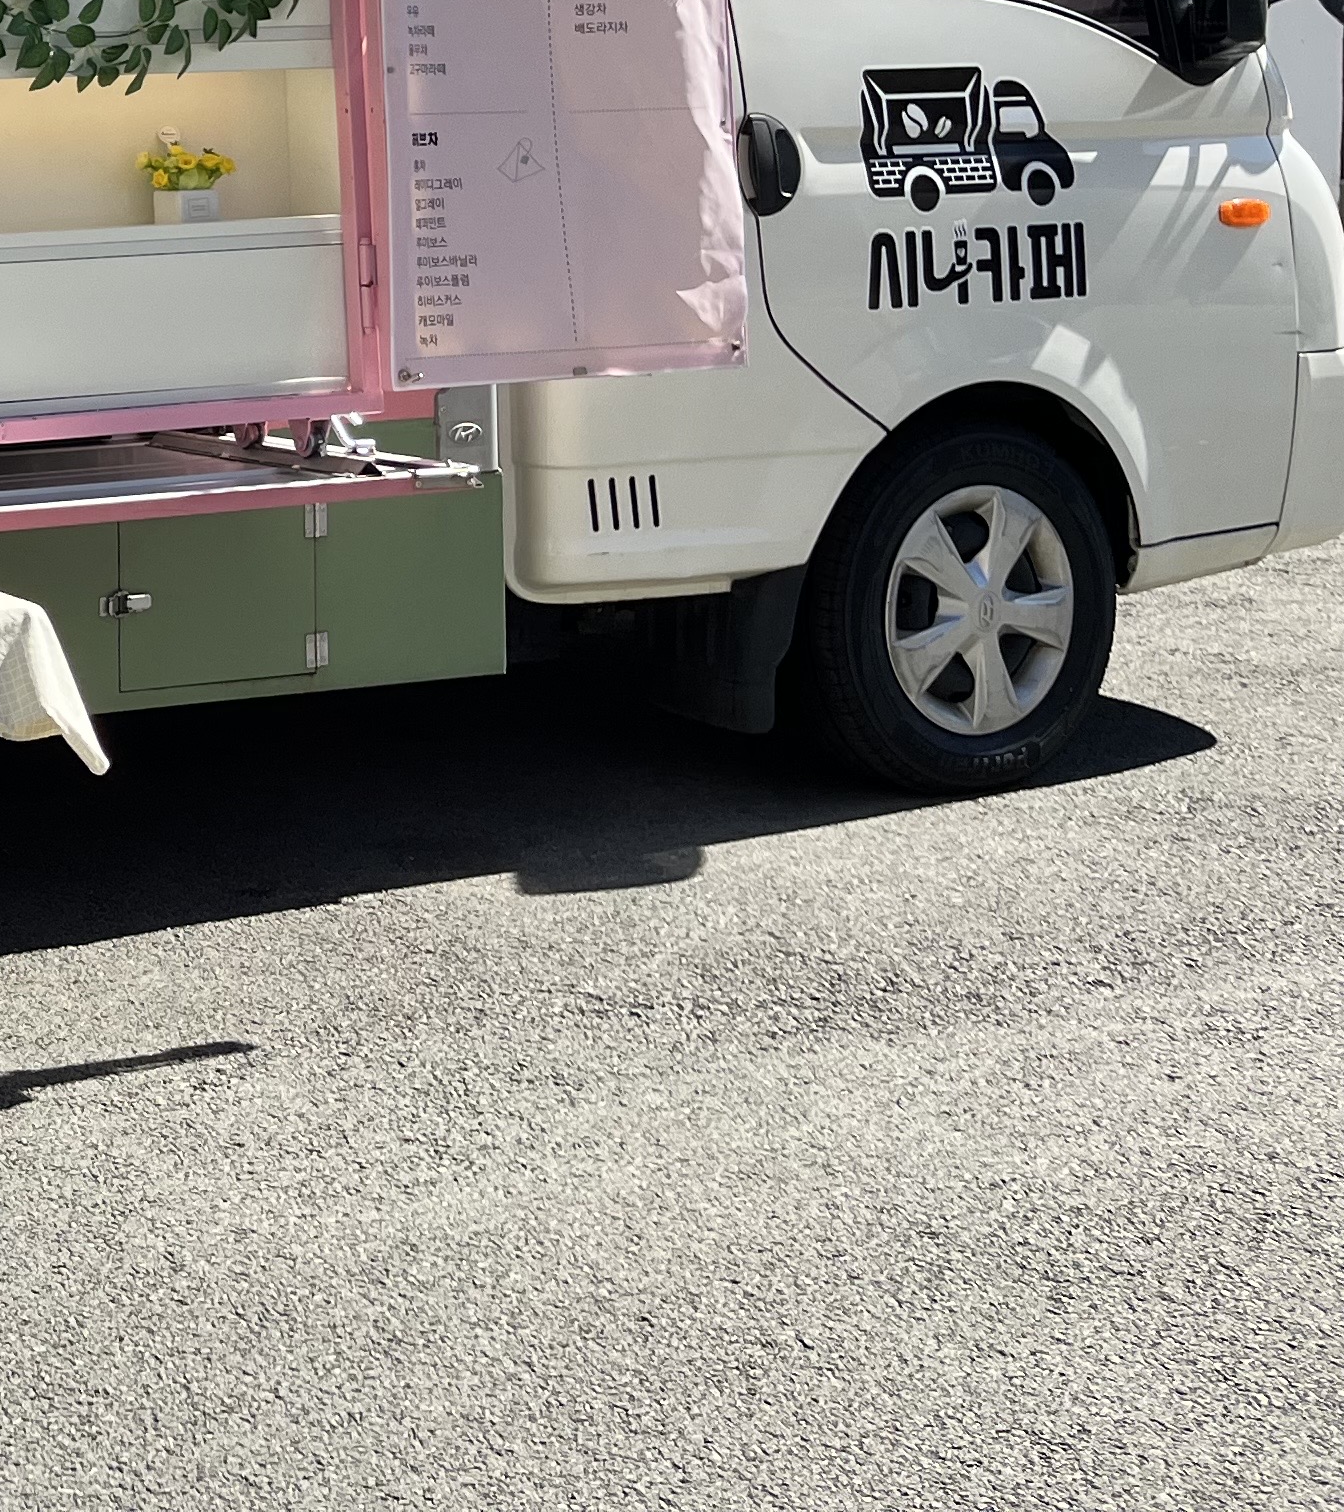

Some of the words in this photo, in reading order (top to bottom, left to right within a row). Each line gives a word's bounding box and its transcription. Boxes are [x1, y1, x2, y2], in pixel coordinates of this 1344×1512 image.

[574, 3, 606, 16] 생강차
[575, 21, 628, 34] 배도라지차
[417, 293, 463, 308] 히비스커스
